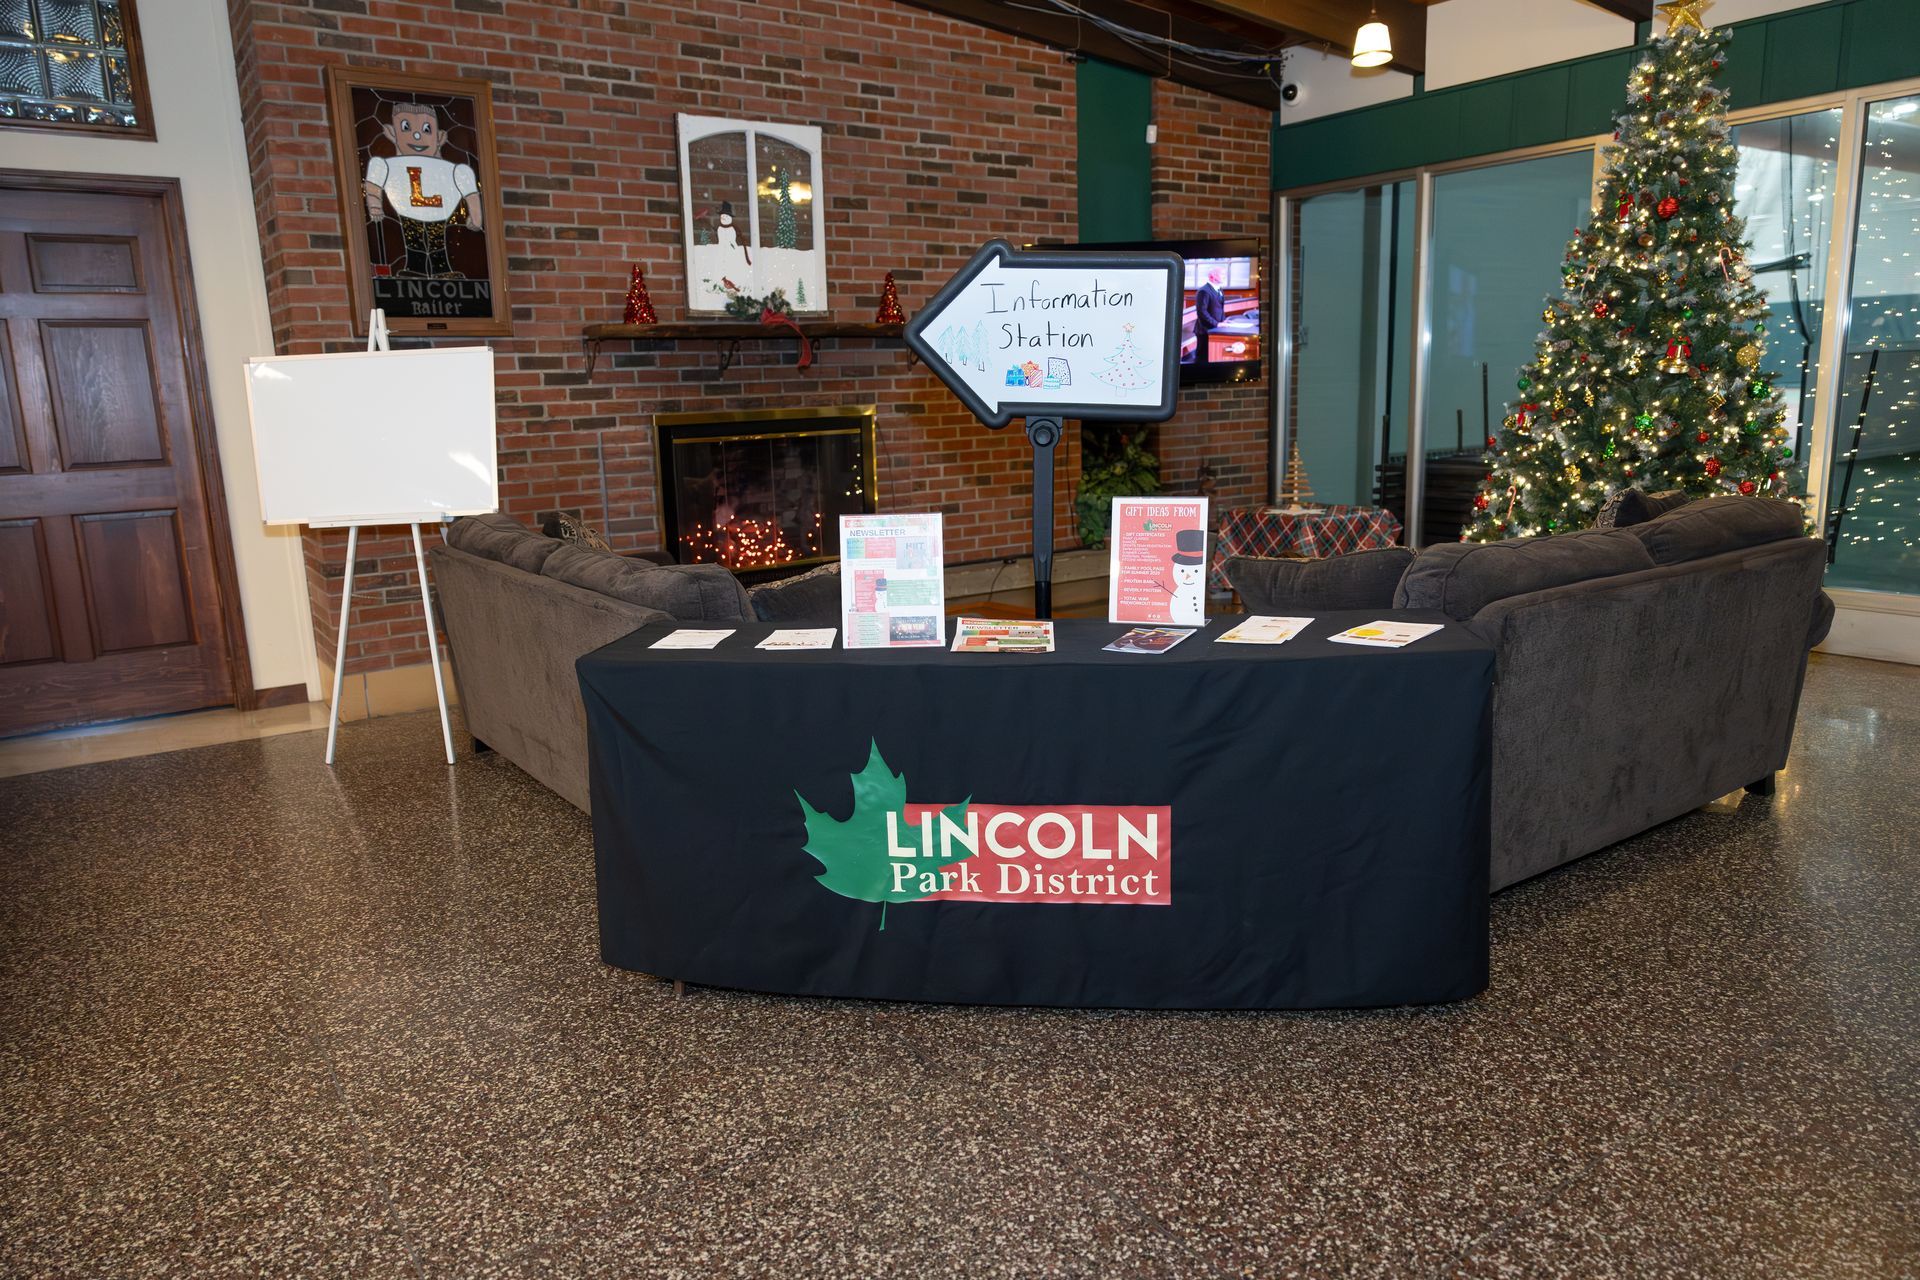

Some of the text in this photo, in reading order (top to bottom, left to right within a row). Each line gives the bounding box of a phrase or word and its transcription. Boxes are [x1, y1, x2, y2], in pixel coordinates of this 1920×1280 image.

[406, 166, 443, 208] L
[375, 279, 490, 300] LINCOLN
[980, 278, 1133, 314] Information
[999, 320, 1094, 350] Station
[1125, 506, 1197, 518] GIFT IDEAS FROM
[1149, 522, 1172, 530] LINCOLN
[849, 528, 906, 537] NEWSLETTER
[886, 811, 1158, 861] LINCOLN
[889, 862, 1160, 896] Park District
